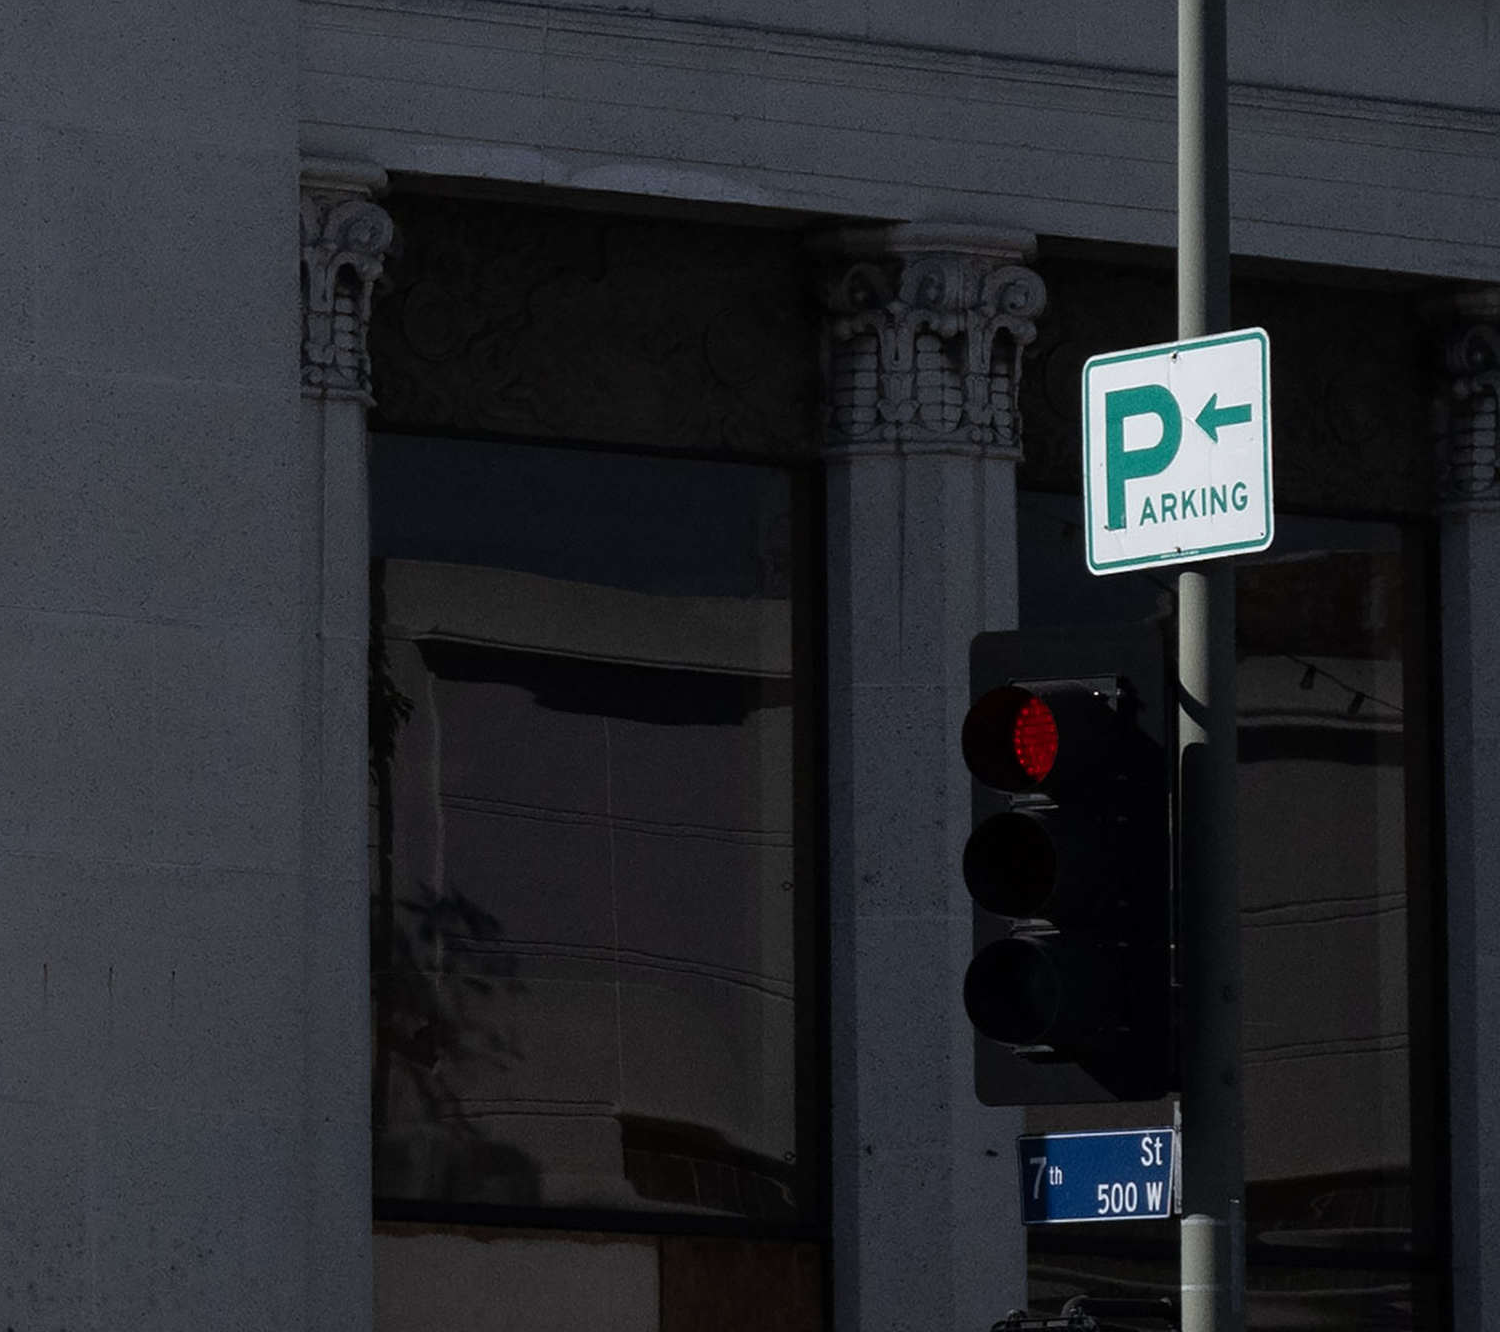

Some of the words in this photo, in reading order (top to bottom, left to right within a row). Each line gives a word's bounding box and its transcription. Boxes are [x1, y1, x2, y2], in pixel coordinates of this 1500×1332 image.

[1105, 383, 1249, 531] PARKING
[1029, 1156, 1063, 1200] 7th
[1140, 1136, 1163, 1167] St
[1097, 1182, 1138, 1214] 500
[1146, 1181, 1163, 1212] W
